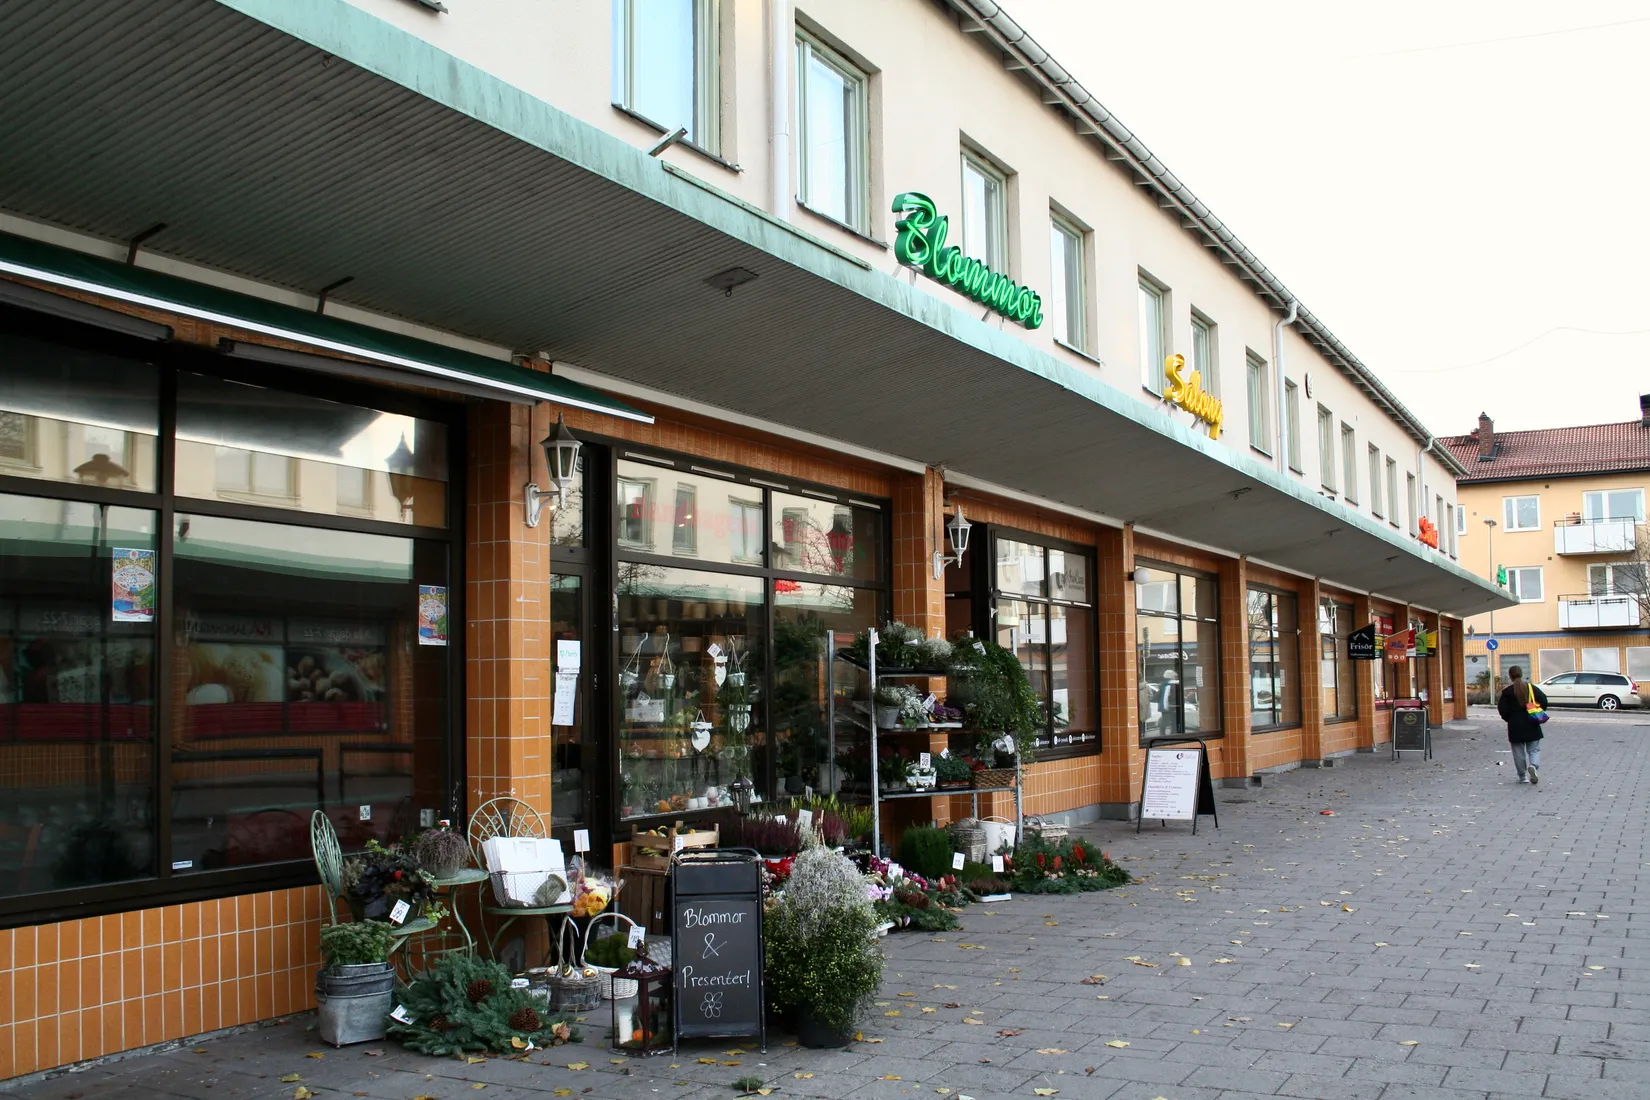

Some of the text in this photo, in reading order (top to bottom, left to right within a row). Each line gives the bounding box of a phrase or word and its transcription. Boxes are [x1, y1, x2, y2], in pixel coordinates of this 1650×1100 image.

[891, 192, 1043, 330] Blommor
[1163, 353, 1224, 440] Salong
[1350, 642, 1373, 650] Frisör
[683, 907, 747, 929] Blommor
[702, 932, 728, 959] &
[682, 965, 750, 988] Presenter!
